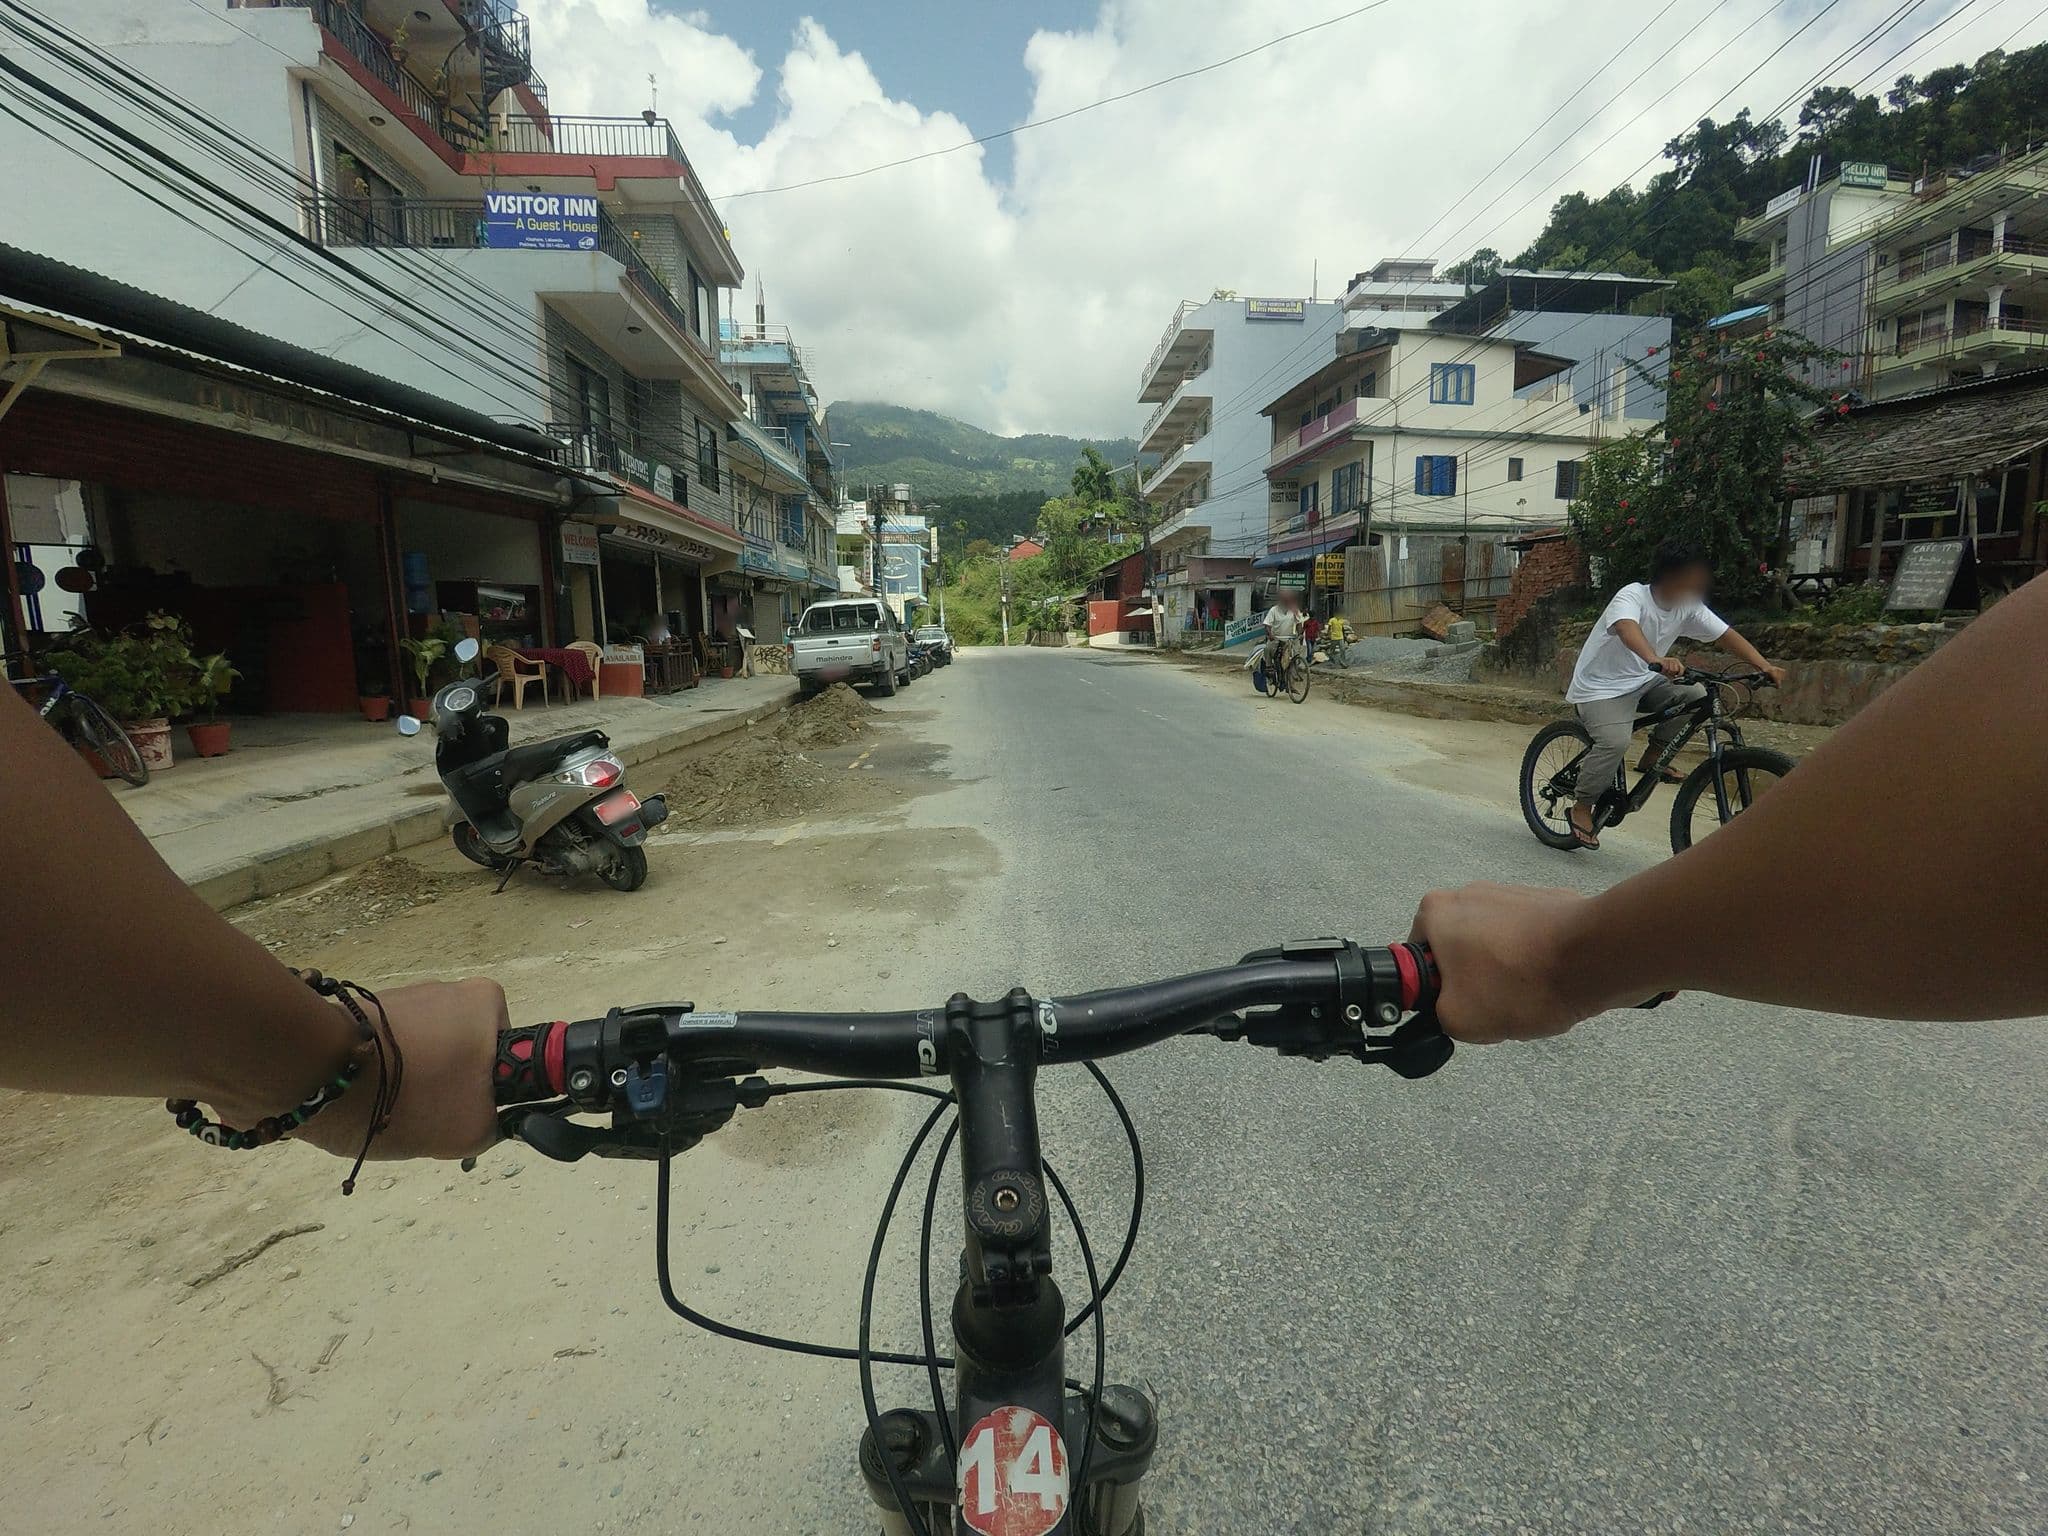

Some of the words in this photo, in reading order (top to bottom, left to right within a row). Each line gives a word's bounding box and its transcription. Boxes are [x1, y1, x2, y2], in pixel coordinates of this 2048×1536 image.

[1844, 163, 1869, 175] HELLO
[1871, 165, 1886, 178] INN
[487, 194, 560, 215] VISITOR
[564, 198, 597, 217] INN
[516, 219, 525, 230] A
[527, 218, 561, 232] Guest
[563, 219, 598, 233] House
[563, 533, 598, 548] WELCOME
[1231, 624, 1247, 637] VIEW
[960, 1425, 1062, 1515] 14
